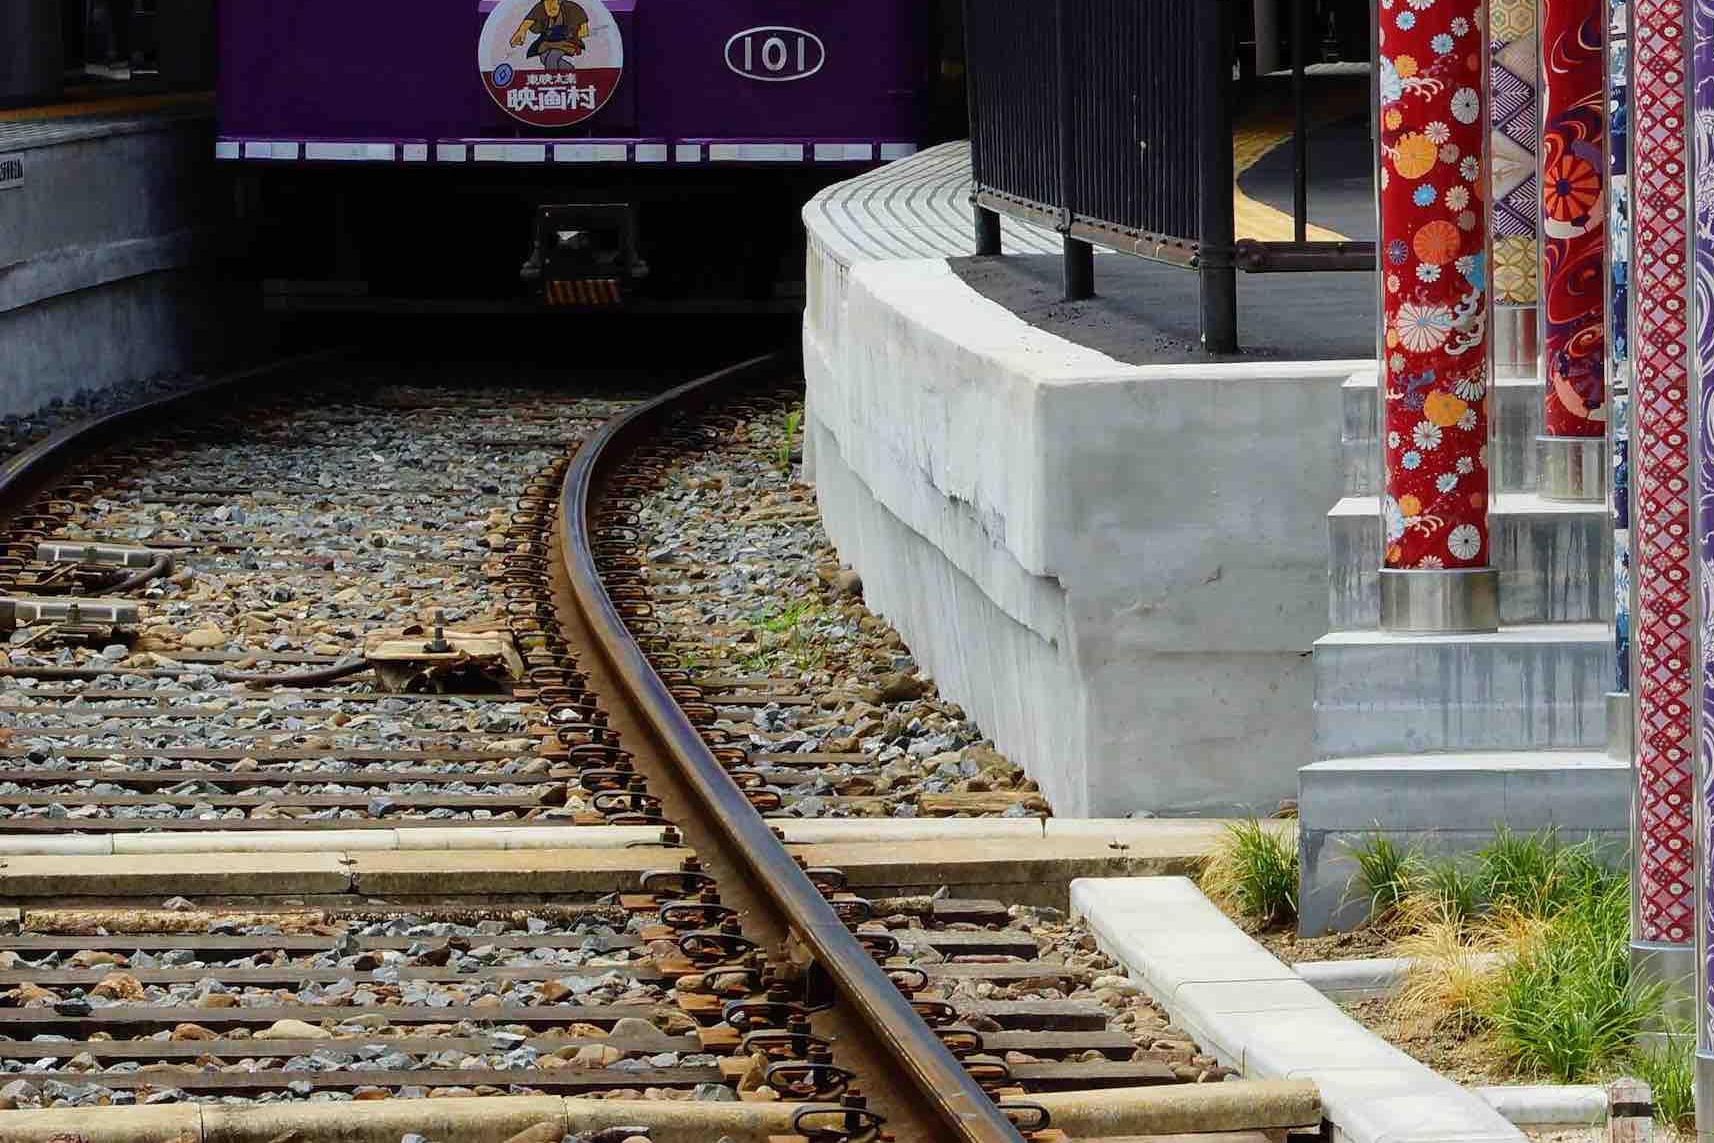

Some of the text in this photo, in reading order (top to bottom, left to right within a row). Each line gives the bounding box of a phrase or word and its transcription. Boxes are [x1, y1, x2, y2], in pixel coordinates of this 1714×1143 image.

[744, 36, 805, 72] 101
[506, 84, 597, 112] 映画村
